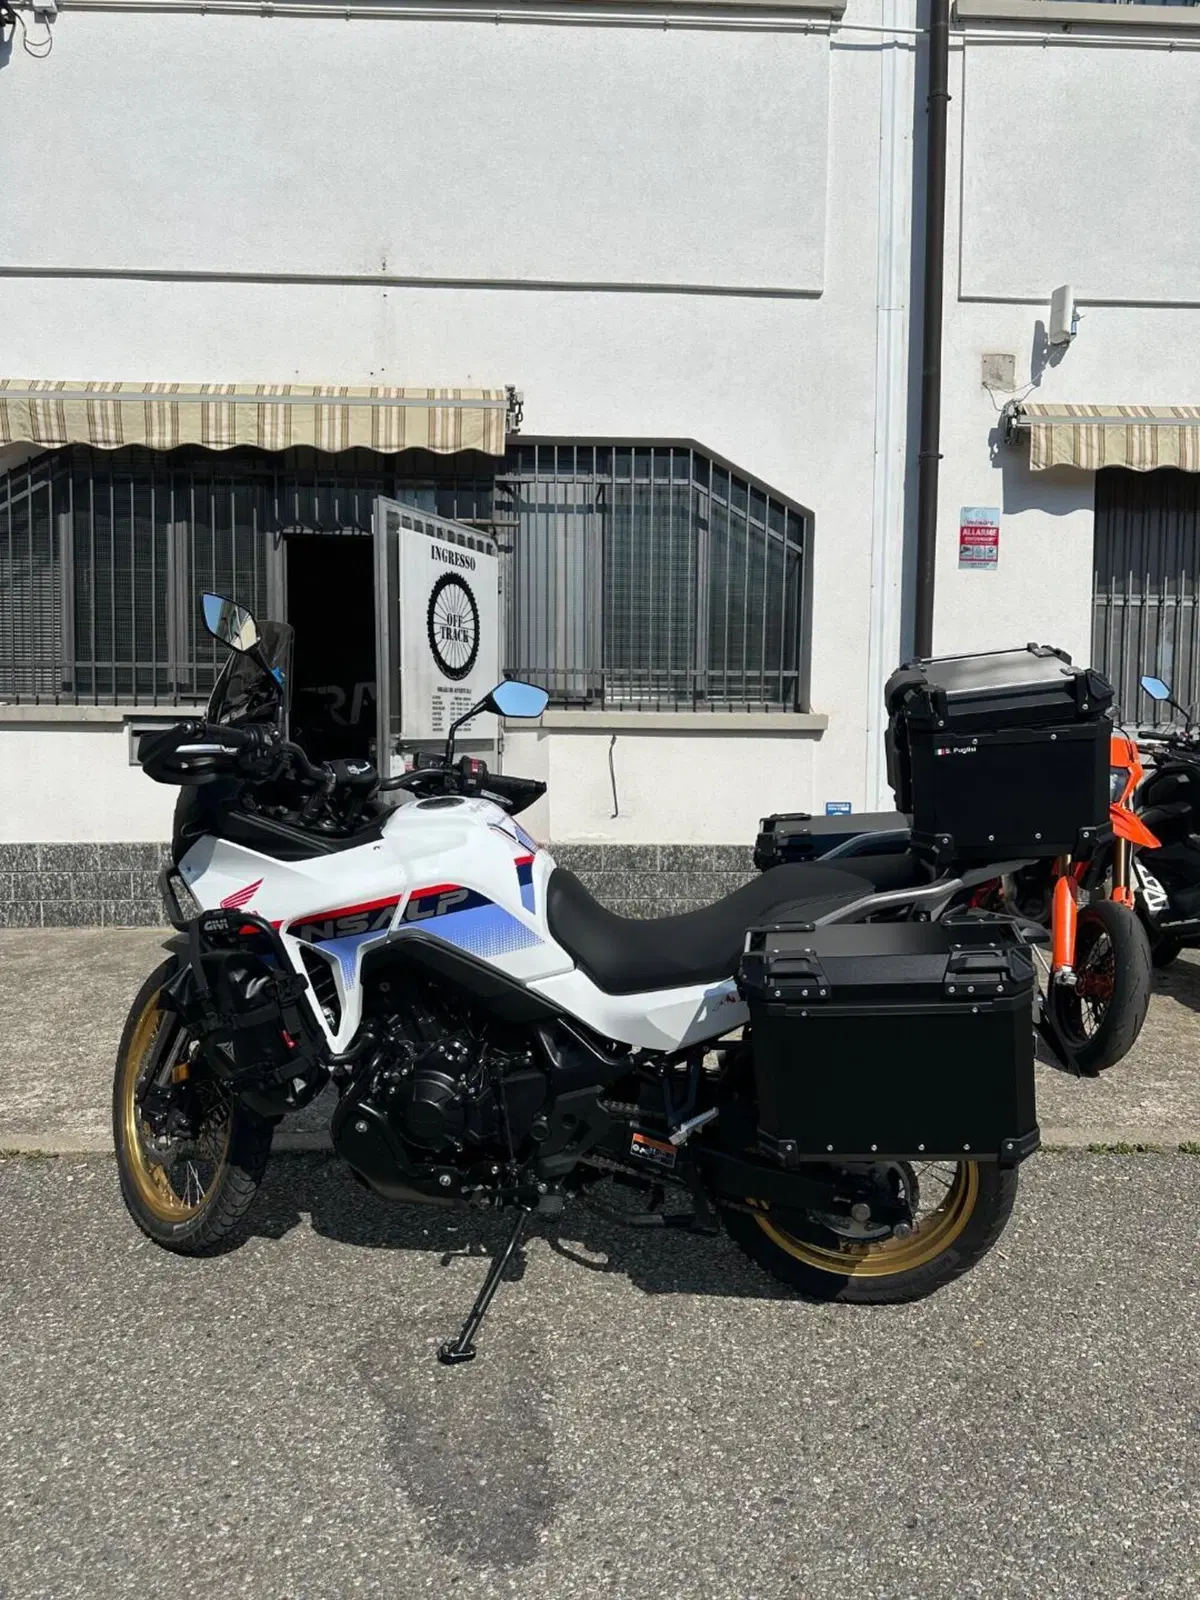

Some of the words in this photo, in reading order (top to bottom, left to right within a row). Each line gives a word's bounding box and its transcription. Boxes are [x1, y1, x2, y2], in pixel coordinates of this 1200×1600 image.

[431, 545, 476, 571] INGRESSO
[447, 613, 463, 628] OFF
[440, 626, 469, 643] TRACK
[204, 918, 229, 931] GIVI
